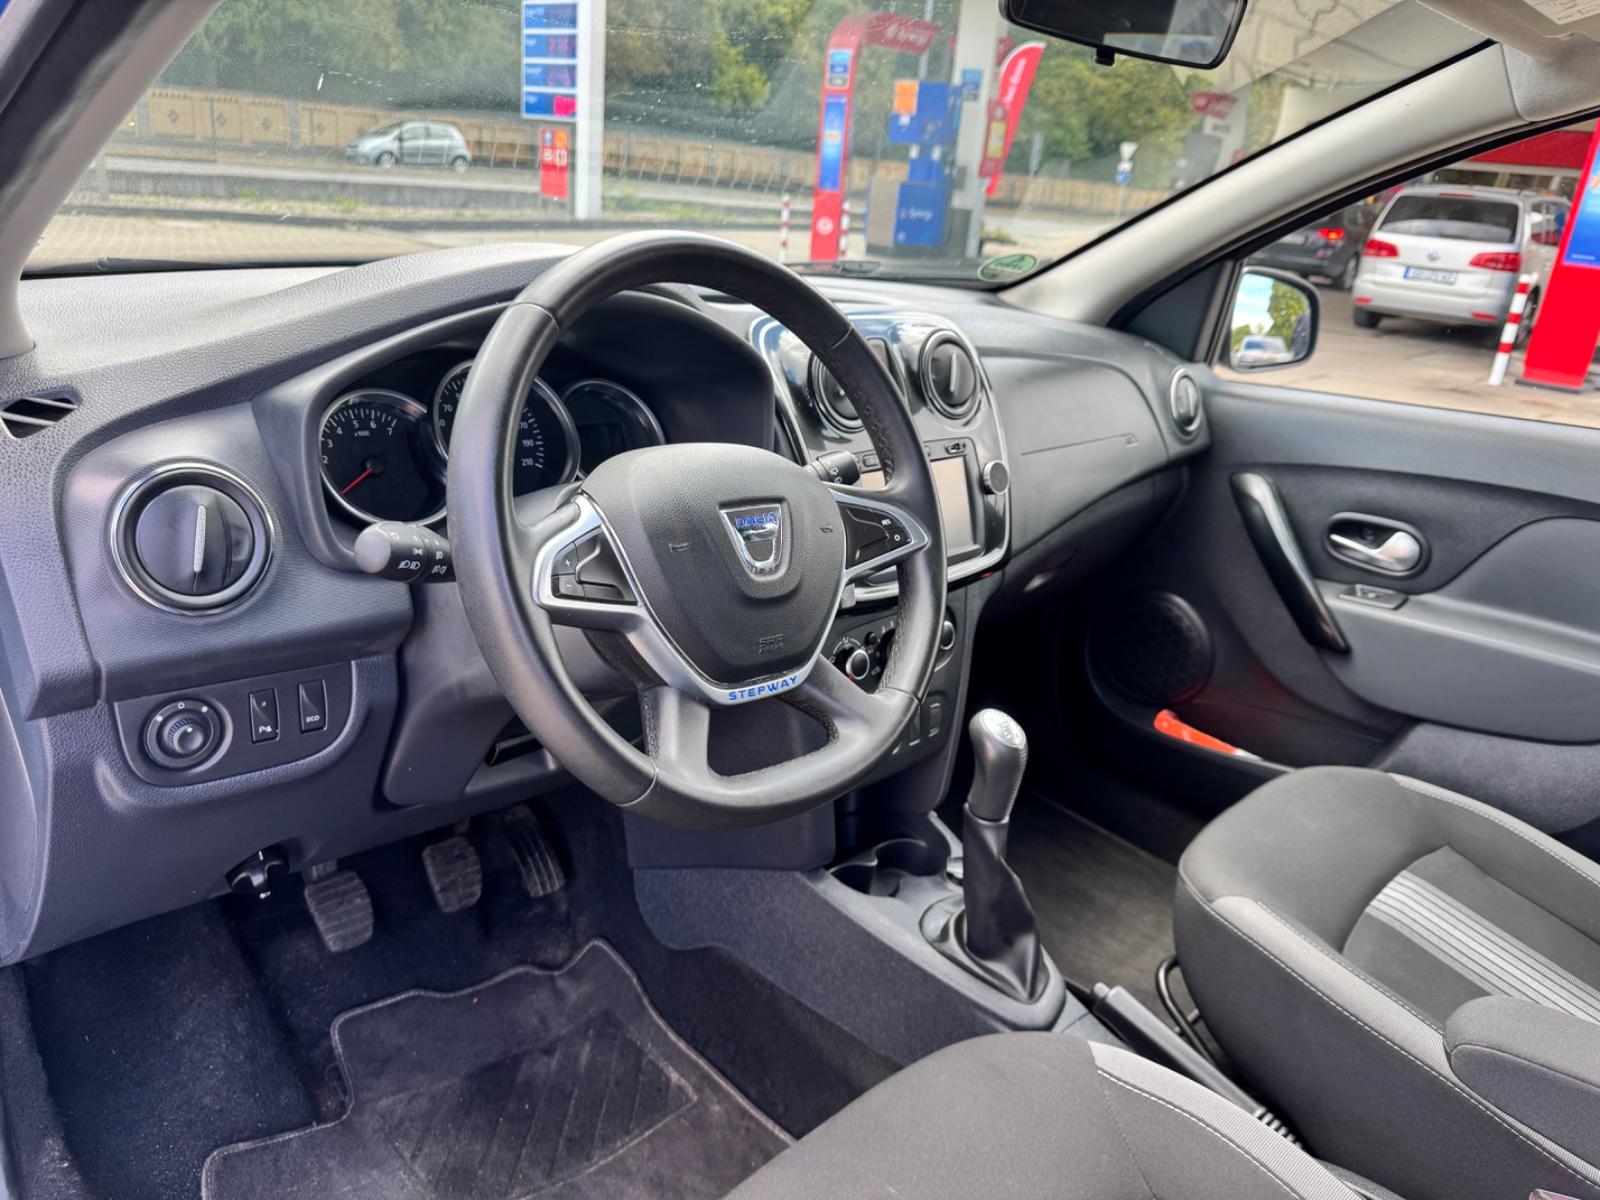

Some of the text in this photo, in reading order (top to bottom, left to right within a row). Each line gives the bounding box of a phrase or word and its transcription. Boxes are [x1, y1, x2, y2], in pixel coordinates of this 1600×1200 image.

[443, 404, 453, 412] 70
[353, 420, 359, 429] 5
[370, 420, 377, 429] 6
[336, 426, 343, 435] 4
[387, 427, 393, 436] 7
[327, 439, 334, 448] 3
[522, 439, 534, 447] 190
[322, 455, 329, 464] 2
[521, 458, 533, 467] 210
[735, 512, 778, 529] DACIA
[728, 675, 797, 701] STEPWAY
[306, 715, 320, 723] ECO
